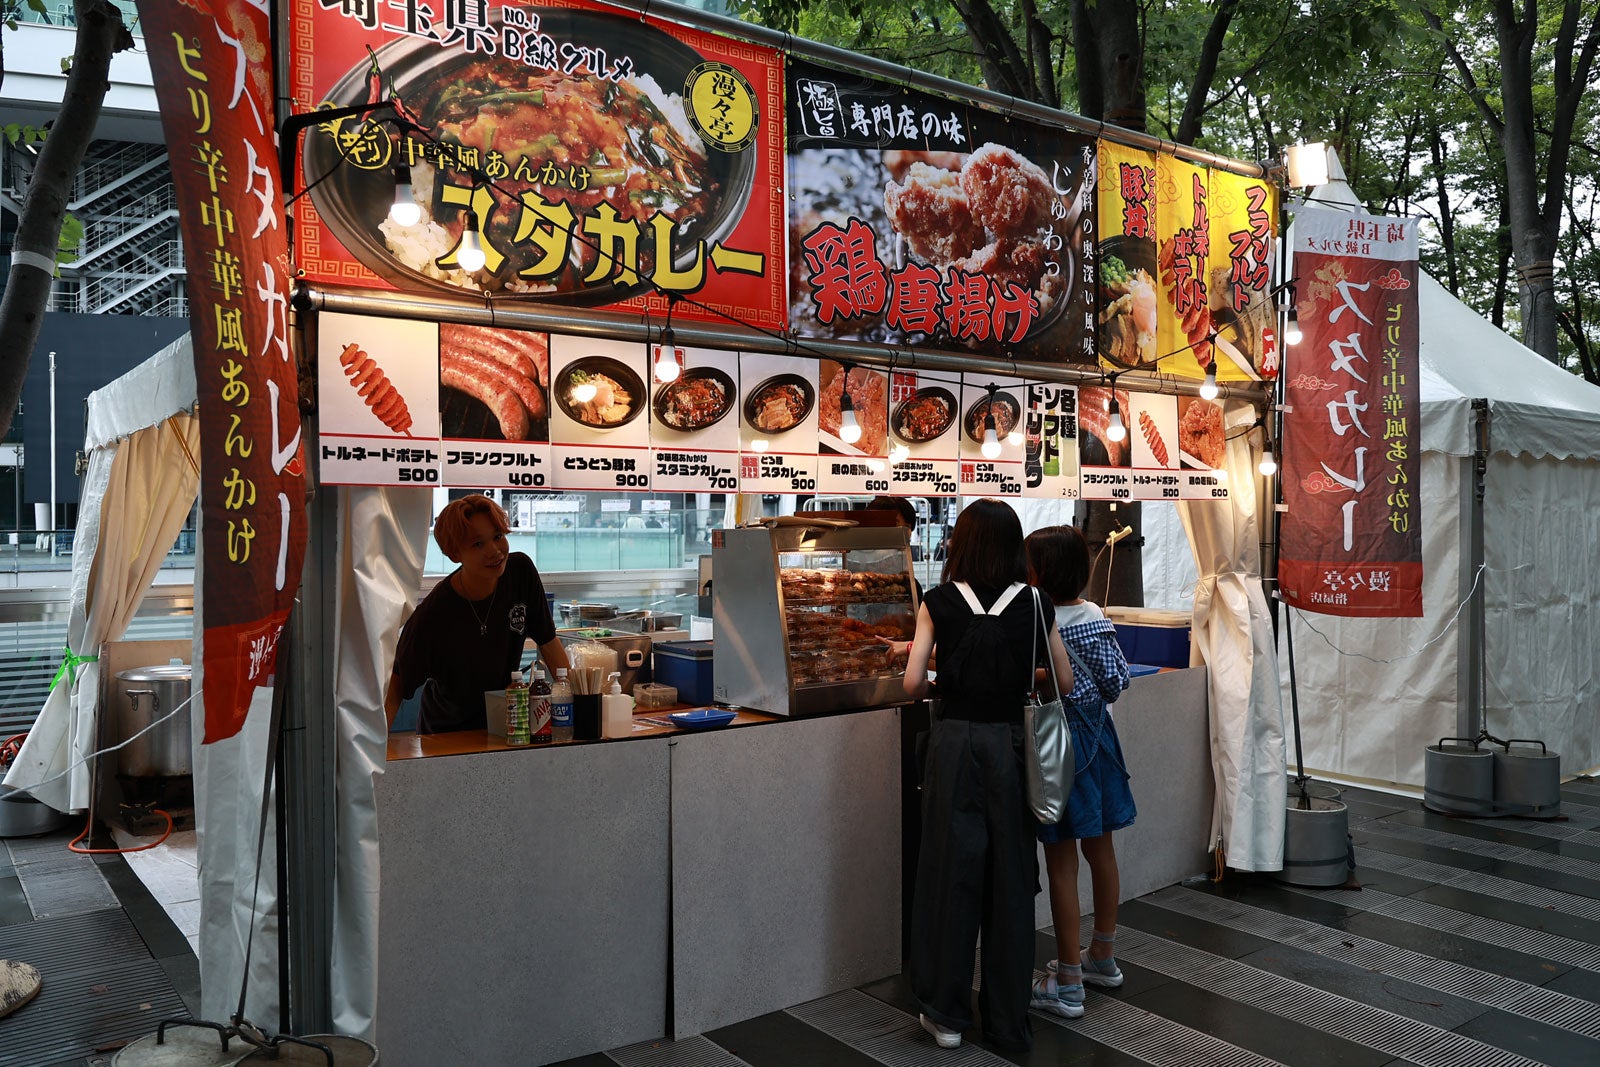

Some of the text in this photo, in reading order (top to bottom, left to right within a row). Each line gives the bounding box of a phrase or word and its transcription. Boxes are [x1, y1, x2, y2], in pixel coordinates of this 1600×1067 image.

[504, 28, 632, 82] B級グルメ
[709, 72, 736, 140] 漫々亭
[803, 82, 835, 136] 極旨
[851, 102, 966, 145] 専門店の味
[1120, 163, 1148, 239] 豚丼
[1043, 160, 1072, 277] じゅわっ
[436, 183, 766, 294] スタカレー
[1192, 172, 1210, 311] トルネード
[1246, 185, 1270, 290] フランク
[1081, 145, 1094, 356] 香辛料の奥深い風味
[1174, 227, 1193, 313] ポテト
[1229, 231, 1250, 313] フルト
[801, 216, 1039, 344] 鶏唐揚げ
[172, 32, 255, 564] ピリ辛中華風あんかけ
[214, 17, 300, 592] スタカレー
[1060, 389, 1076, 438] 各種
[1044, 387, 1060, 462] ソフト
[1026, 385, 1043, 488] ドリンク
[322, 446, 438, 463] トルネードポテト
[447, 451, 542, 466] フランクフルト
[657, 453, 707, 463] 中華風あんかけ
[564, 457, 636, 471] とろとろ豚丼
[657, 464, 731, 476] スタミナカレー
[399, 468, 438, 482] 500
[509, 473, 545, 486] 400
[616, 474, 648, 486] 900
[761, 467, 807, 478] スタカレー
[893, 471, 952, 482] スタミナカレー
[976, 473, 1014, 483] スタカレー
[1083, 475, 1128, 485] フランクフルト
[1133, 475, 1179, 485] トルネードポテト
[708, 477, 737, 489] 700
[791, 479, 815, 490] 900
[865, 480, 889, 490] 600
[934, 483, 956, 492] 700
[1000, 484, 1021, 493] 900
[1062, 488, 1078, 497] 250
[1112, 489, 1129, 498] 400
[1162, 488, 1179, 497] 500
[1211, 488, 1228, 497] 600
[533, 699, 551, 725] JAVA
